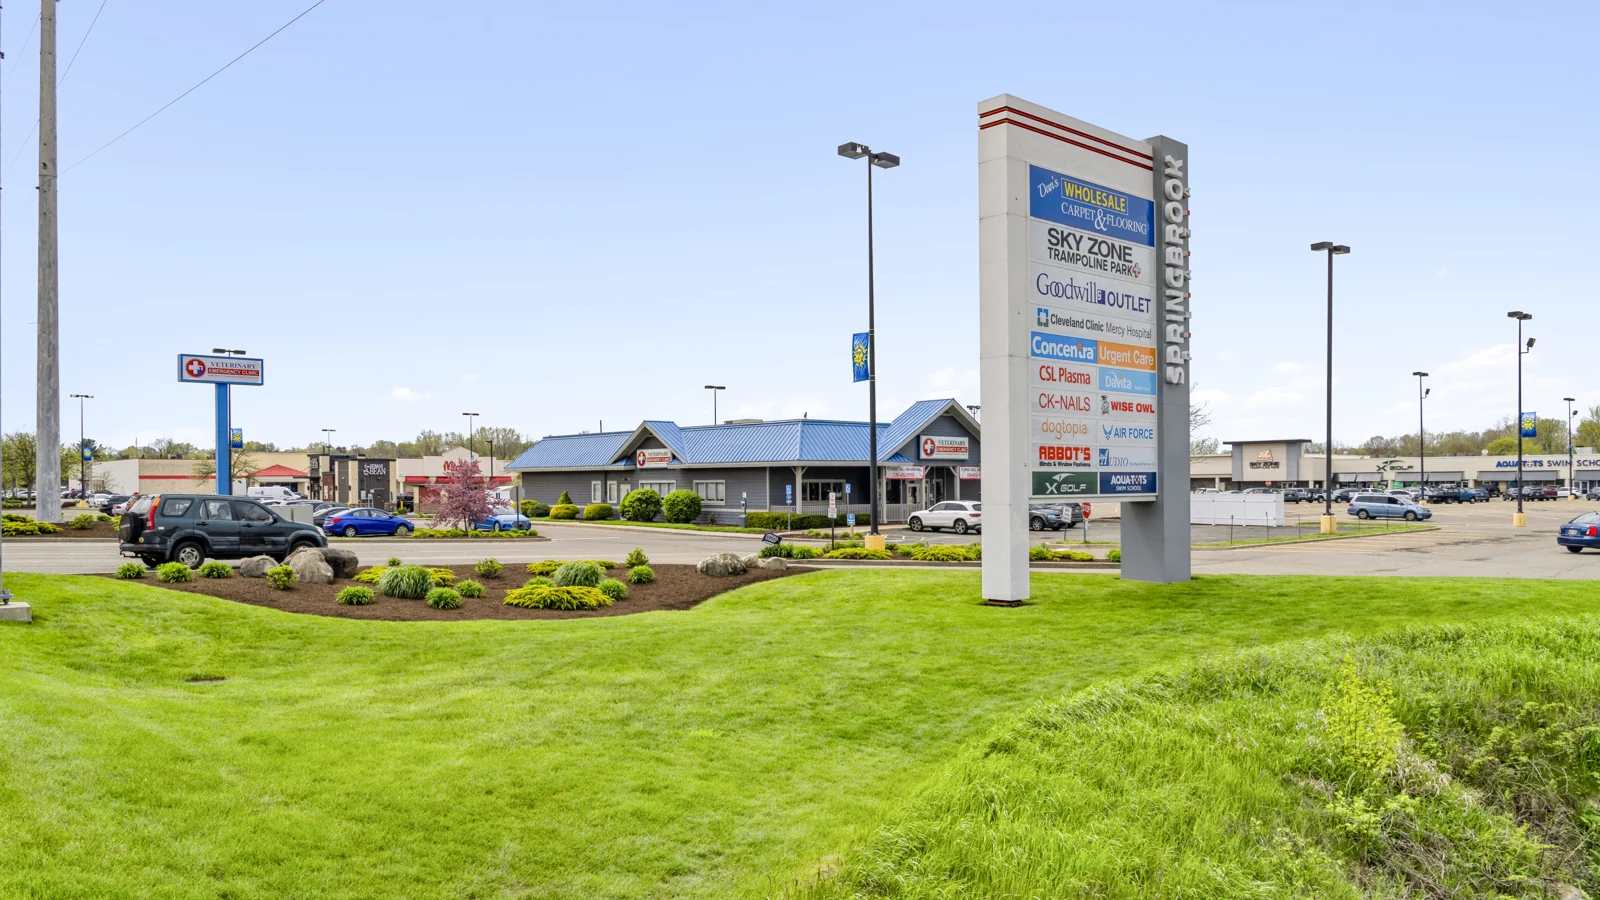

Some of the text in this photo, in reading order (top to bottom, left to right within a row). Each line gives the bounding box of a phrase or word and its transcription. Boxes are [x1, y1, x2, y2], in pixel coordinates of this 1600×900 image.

[1037, 176, 1059, 198] Dan's
[1064, 181, 1126, 213] WHOLESALE
[1061, 202, 1147, 235] CARPET & FLOORING
[1047, 227, 1133, 263] SKY ZONE
[1047, 246, 1133, 278] TRAMPOLINE PARK
[1164, 154, 1185, 384] SPRINGBROOK
[1036, 273, 1151, 314] Goodwill OUTLET
[1050, 313, 1152, 340] Cleveland Clinic Mercy Hospital
[1032, 336, 1154, 366] Concentra Urgent Care
[210, 361, 256, 370] VETERINARY
[1039, 365, 1091, 385] CSL Plasma
[1038, 393, 1091, 412] CK-NAILS
[1110, 401, 1155, 414] WISE OWL
[1041, 418, 1088, 440] dogtopia
[1113, 427, 1153, 439] AIR FORCE
[1039, 446, 1091, 461] ABBOT'S
[1060, 484, 1087, 492] GOLF
